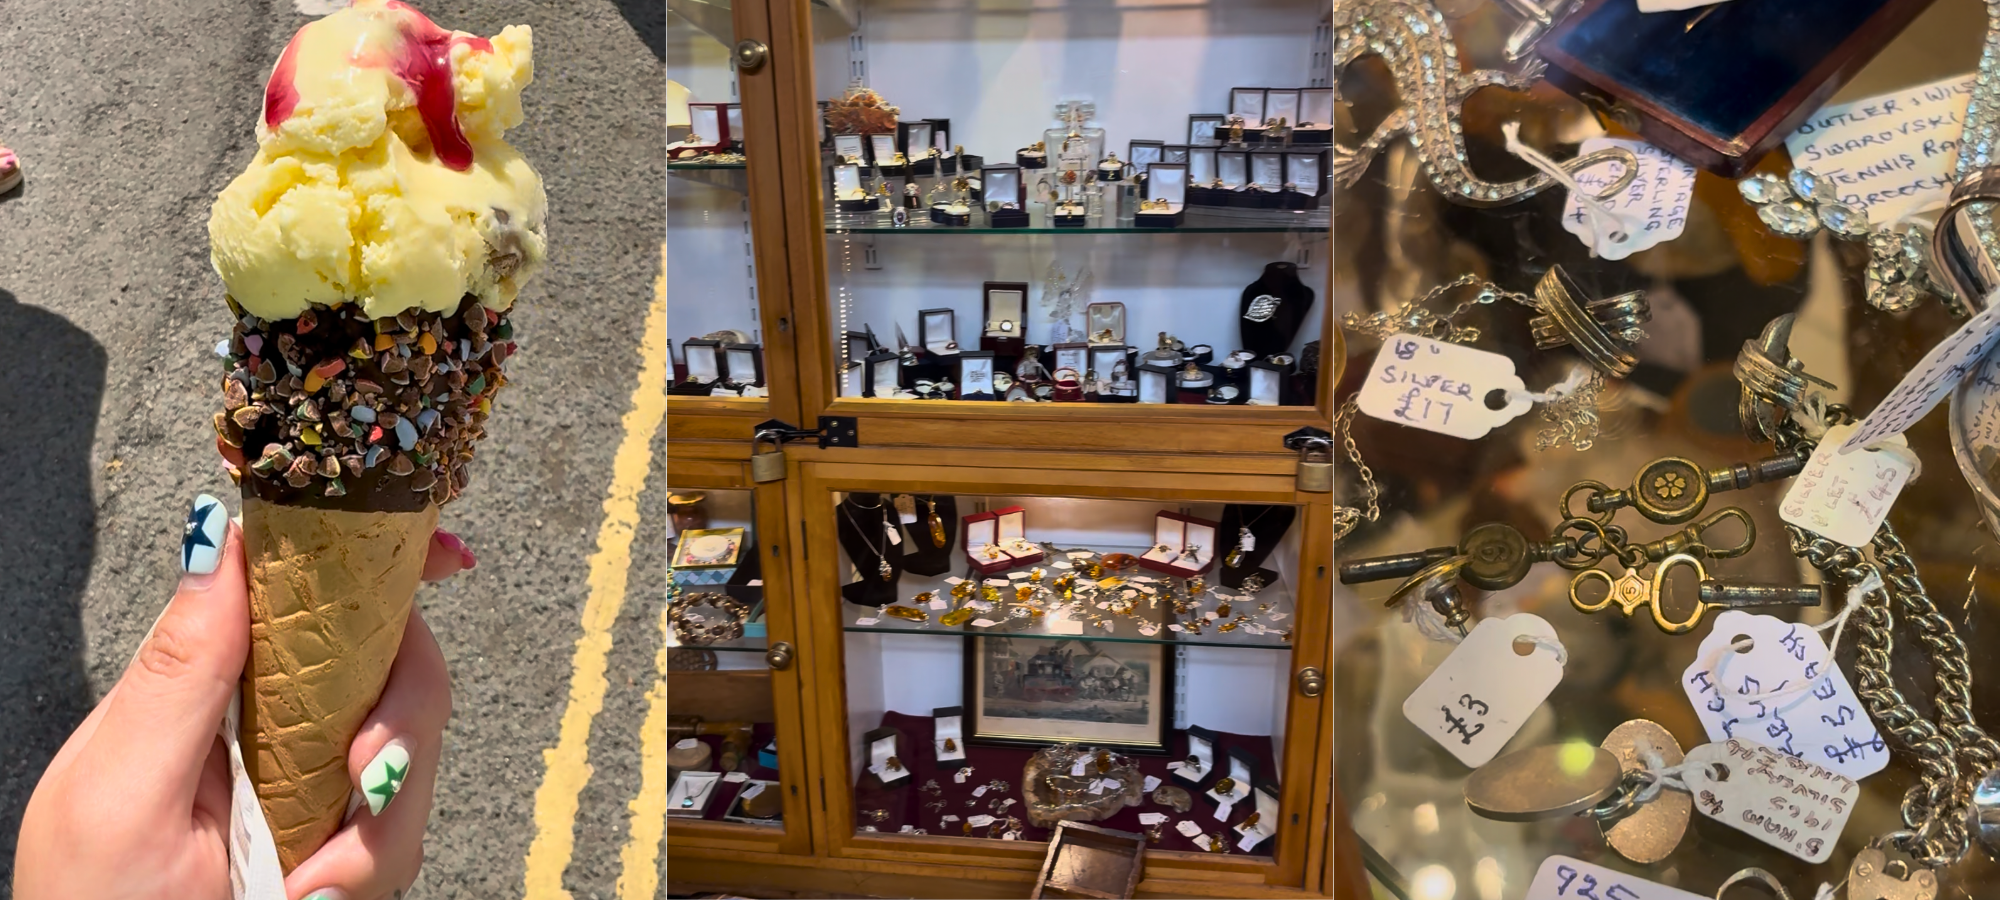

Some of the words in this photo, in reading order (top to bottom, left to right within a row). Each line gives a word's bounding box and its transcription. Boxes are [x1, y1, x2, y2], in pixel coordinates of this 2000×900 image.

[1804, 111, 1962, 161] SWAROVSKI
[1624, 145, 1657, 208] SILVER
[1643, 148, 1675, 232] STERLING
[1666, 163, 1695, 230] INTAGE
[1823, 153, 1915, 188] TENNIS
[1380, 365, 1473, 402] SILVER
[1393, 387, 1453, 426] £17
[1784, 452, 1833, 518] SILVER
[1441, 693, 1489, 745] £3
[1690, 670, 1740, 739] TCH
